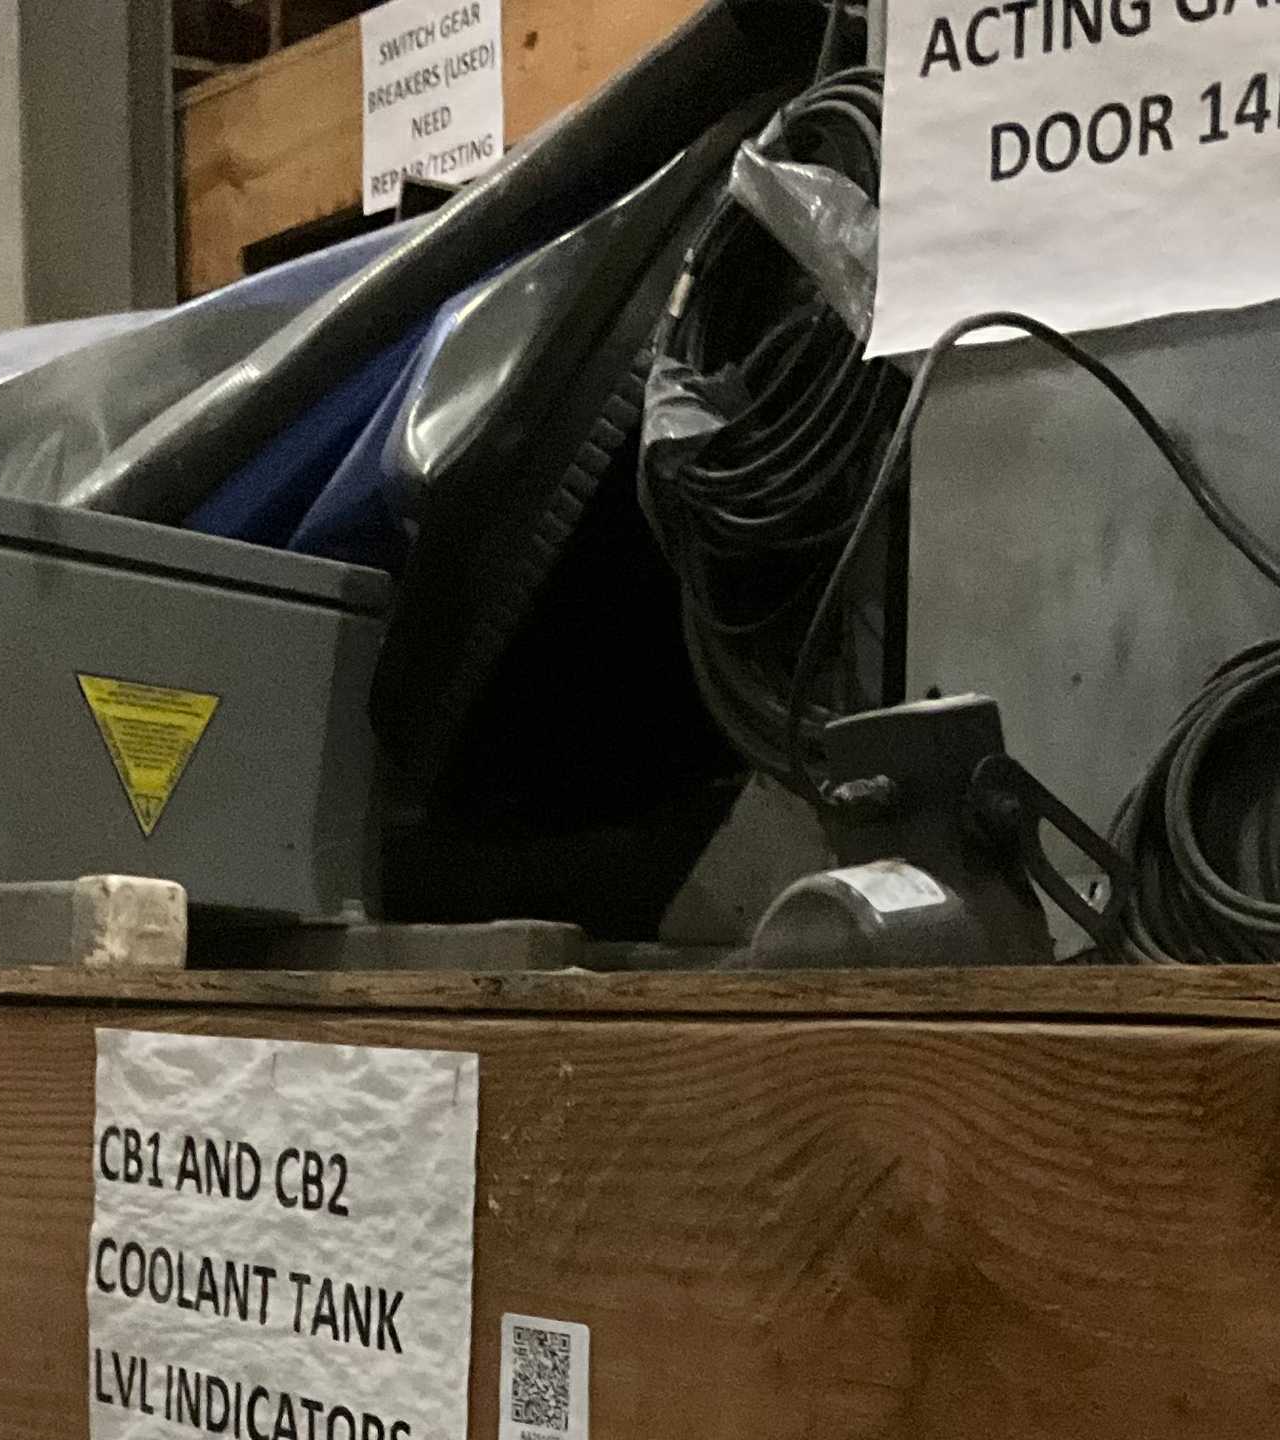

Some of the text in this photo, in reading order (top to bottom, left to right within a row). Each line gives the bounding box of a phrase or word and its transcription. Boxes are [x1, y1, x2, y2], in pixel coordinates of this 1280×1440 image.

[379, 2, 481, 64] SWITCH GEAR
[919, 0, 1152, 77] ACTING
[368, 40, 495, 114] BREAKERS (USED)
[411, 106, 452, 140] NEED
[990, 94, 1175, 182] DOOR
[99, 1126, 350, 1217] CB1 AND CB2
[94, 1237, 405, 1354] COOLANT TANK
[94, 1347, 156, 1416] LVL
